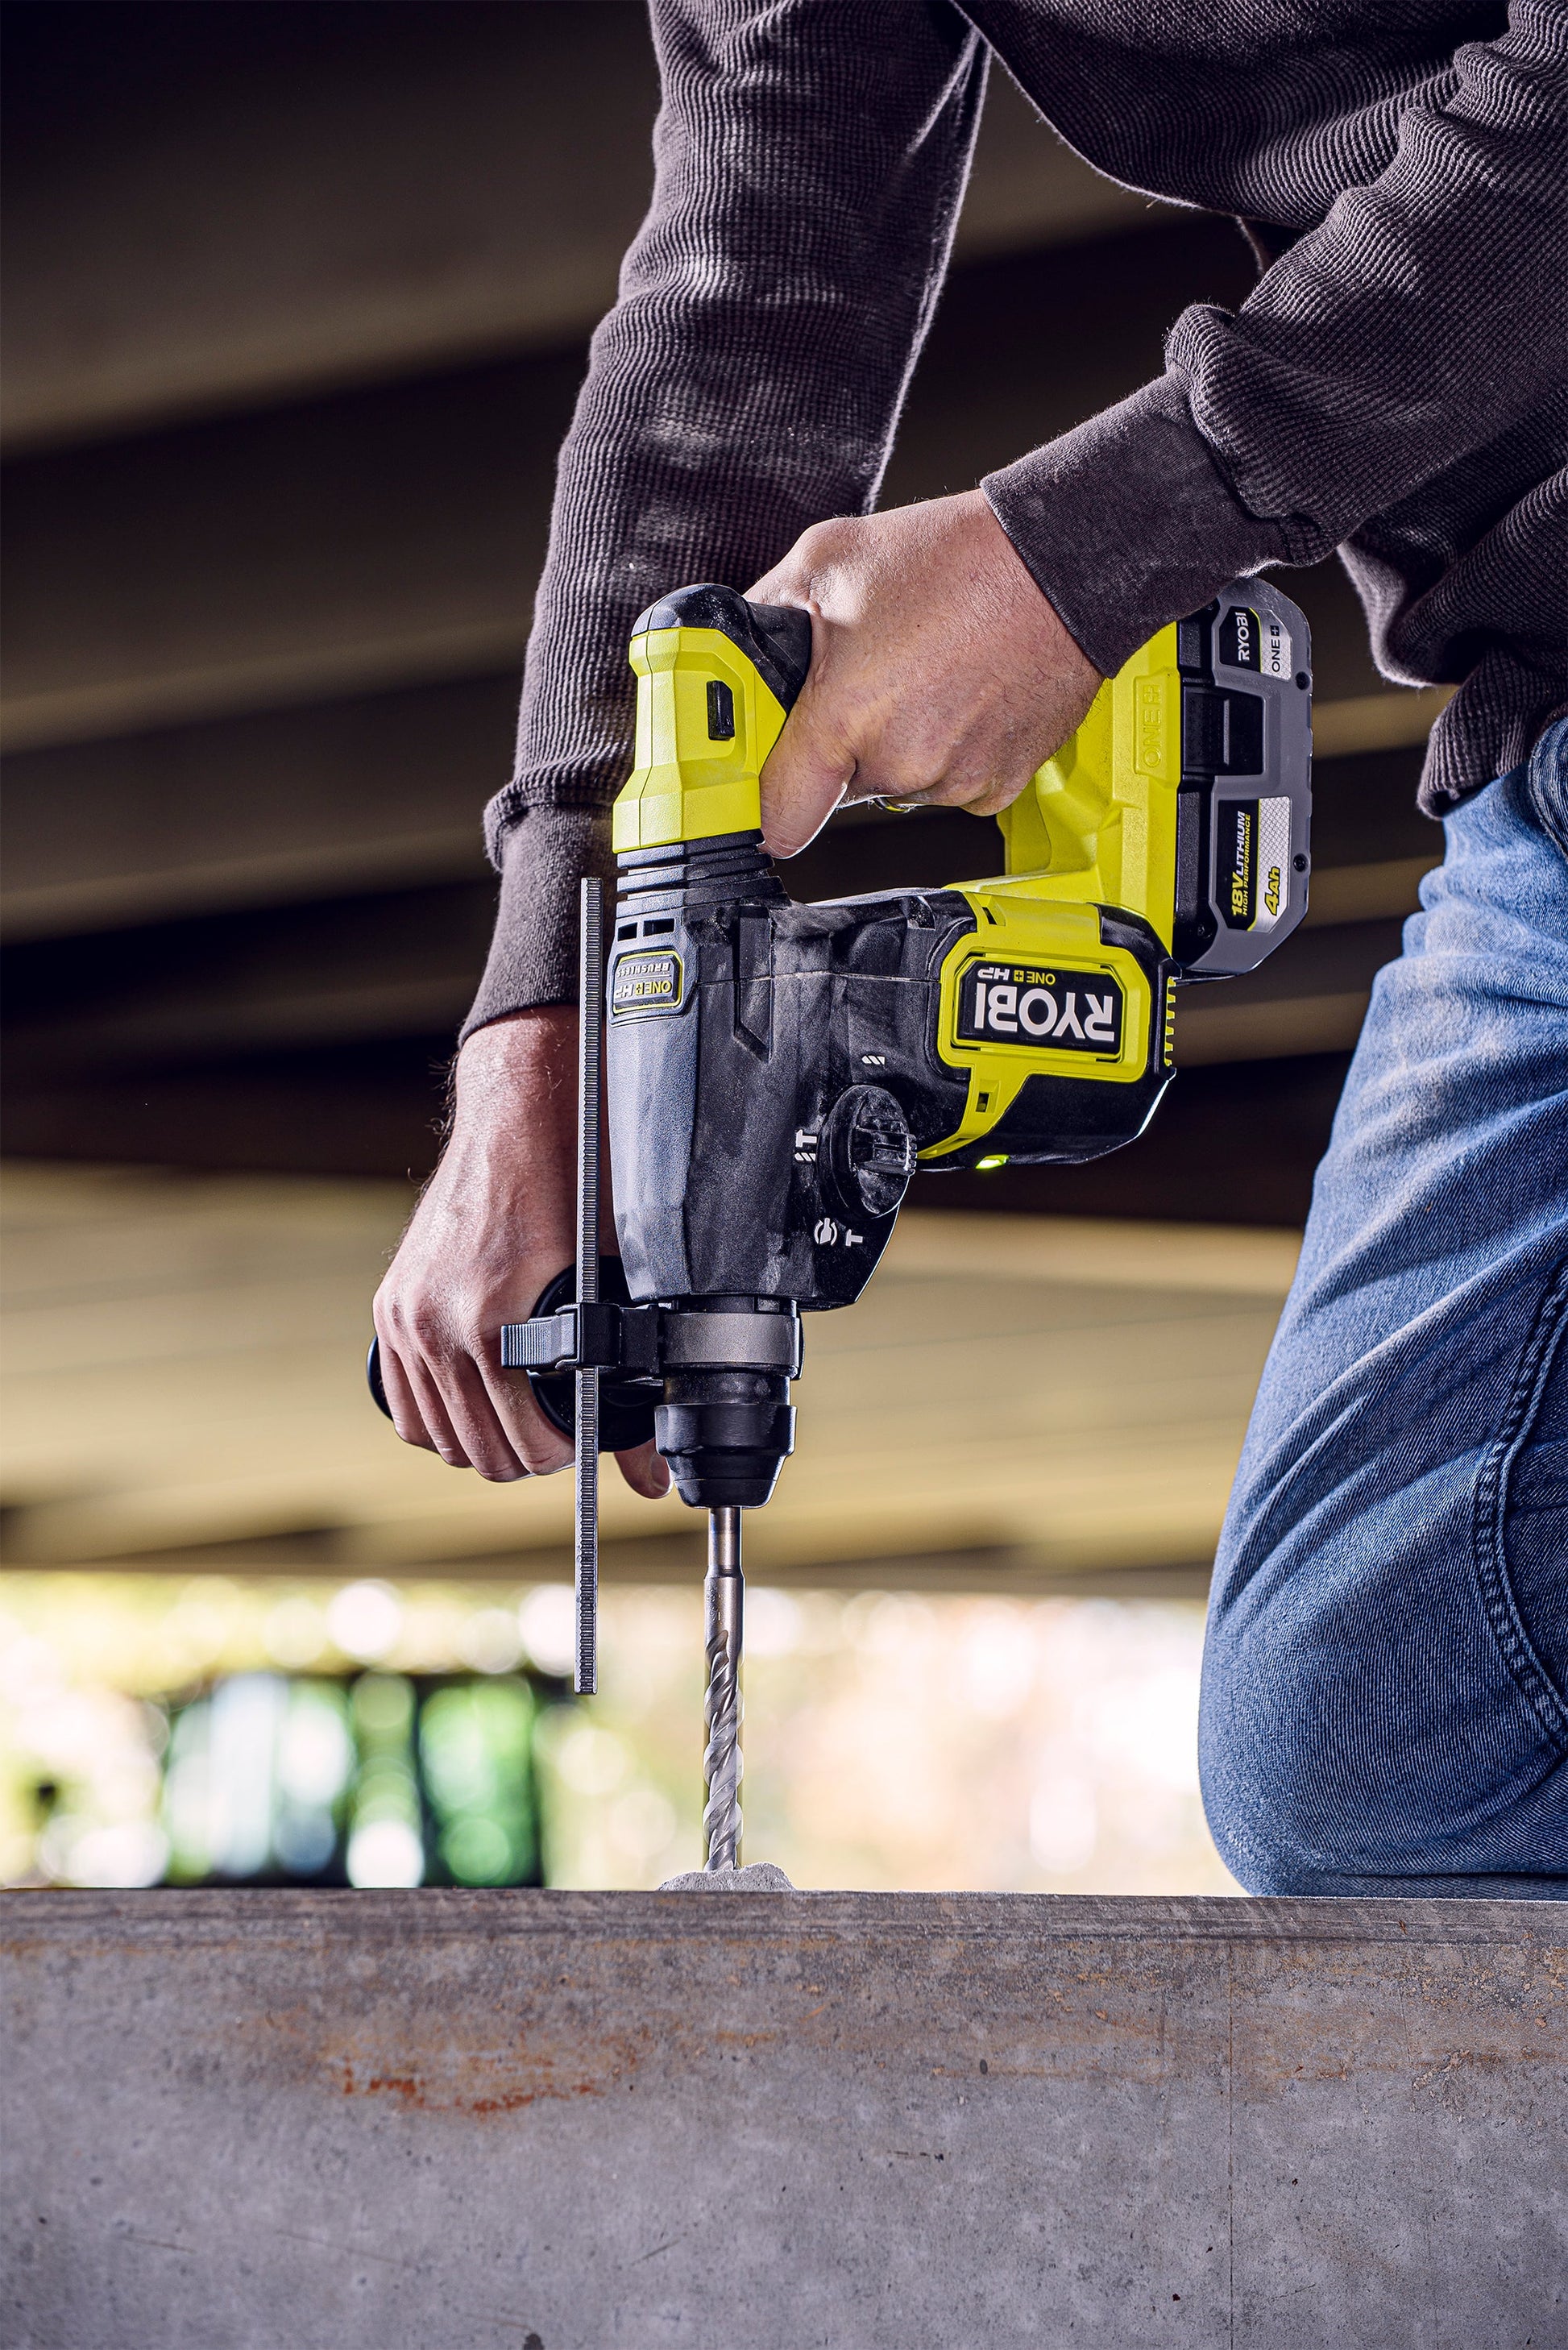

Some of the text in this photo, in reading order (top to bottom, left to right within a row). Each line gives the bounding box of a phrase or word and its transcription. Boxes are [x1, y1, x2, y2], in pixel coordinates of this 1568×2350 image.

[1235, 612, 1250, 661] RYOBI
[1235, 811, 1246, 876] LITHIUM
[1243, 813, 1251, 888] PERFORMANCE
[1265, 866, 1281, 916] 4Ah
[615, 984, 634, 999] HP
[616, 962, 670, 978] BRUSHLESS
[977, 967, 1010, 981] HP
[974, 982, 1115, 1042] RYOBI
